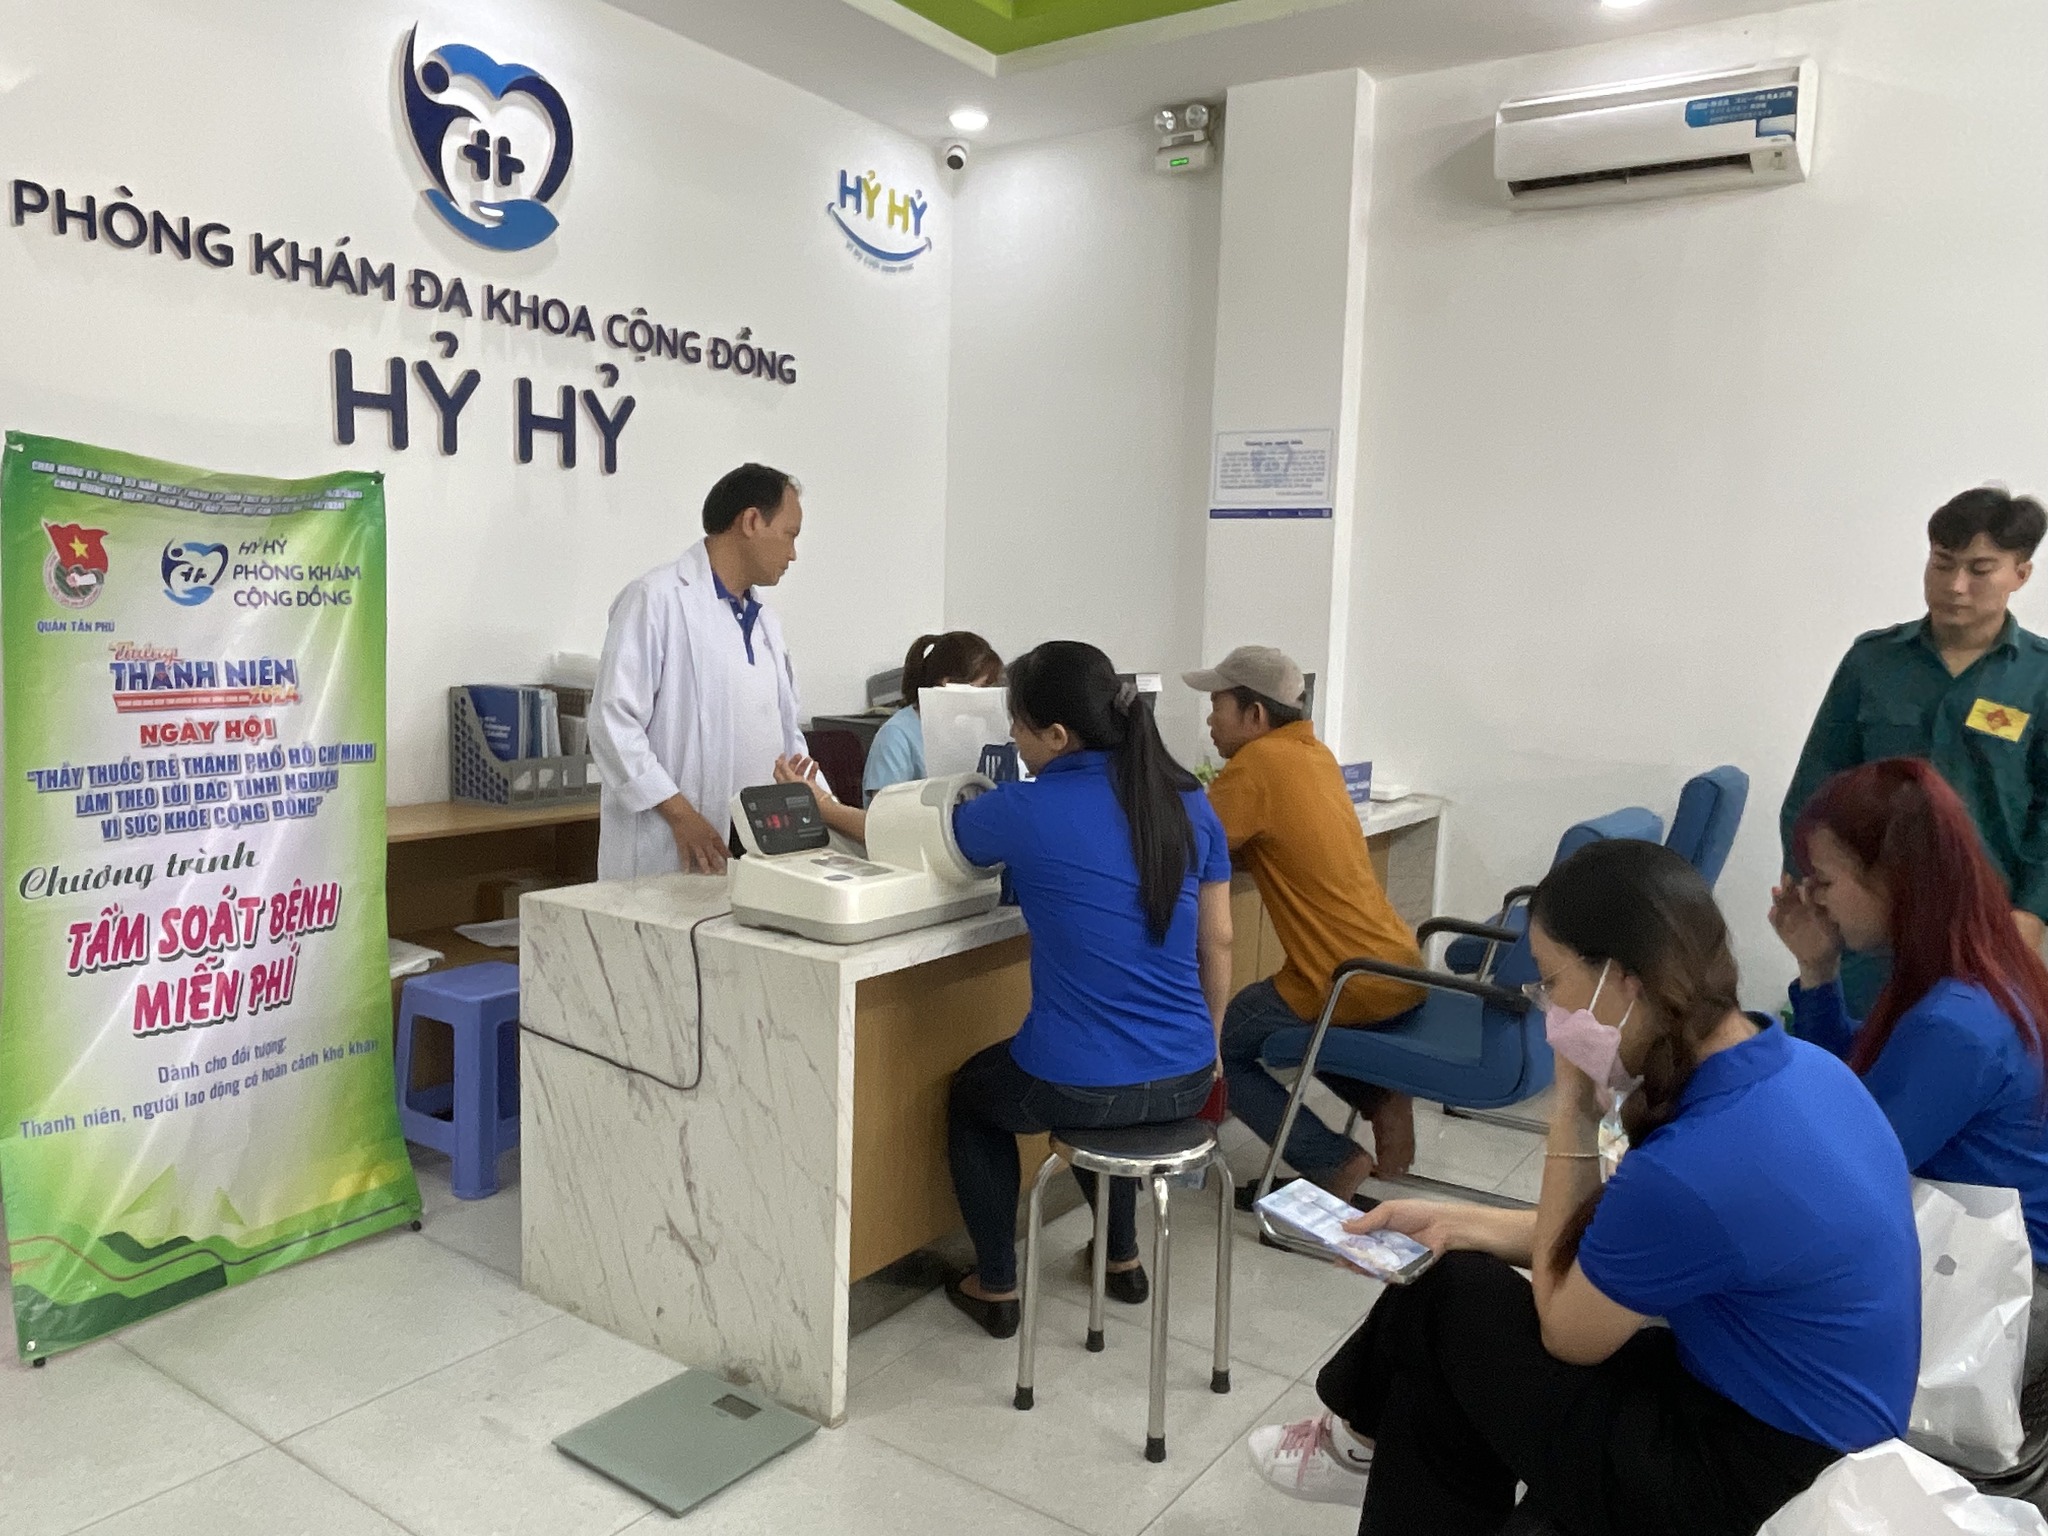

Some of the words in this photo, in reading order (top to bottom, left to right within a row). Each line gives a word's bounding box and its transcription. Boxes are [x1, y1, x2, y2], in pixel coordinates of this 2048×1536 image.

[839, 170, 882, 220] HỶ
[12, 179, 234, 268] PHÒNG
[253, 233, 396, 301] KHÁM
[408, 268, 473, 318] ĐA
[485, 284, 596, 341] KHOA
[606, 307, 702, 365] CỘNG
[707, 325, 798, 385] ĐỒNG
[333, 330, 481, 457] HỶ
[515, 363, 637, 476] HỶ
[233, 560, 304, 581] PHÒNG
[309, 562, 362, 581] KHÁM
[234, 586, 292, 609] CỘNG
[297, 584, 353, 607] ĐỒNG
[109, 661, 218, 691] THANH
[225, 657, 299, 687] NIÊN
[140, 717, 218, 746] NGÀY
[225, 715, 277, 745] HỘI
[245, 746, 285, 772] PHỐ
[341, 742, 375, 763] MINH
[117, 788, 157, 813] THEO
[214, 801, 271, 830] CỘNG
[167, 841, 258, 879] trình
[158, 885, 265, 960] SOÁT
[269, 879, 341, 947] BỆNH
[133, 955, 243, 1036] MIỄN
[247, 942, 300, 1014] PHÍ
[158, 1061, 199, 1084] Dành
[205, 1056, 227, 1074] cho
[20, 1115, 75, 1139] Thanh
[83, 1107, 126, 1128] niên,
[185, 1090, 206, 1108] lao
